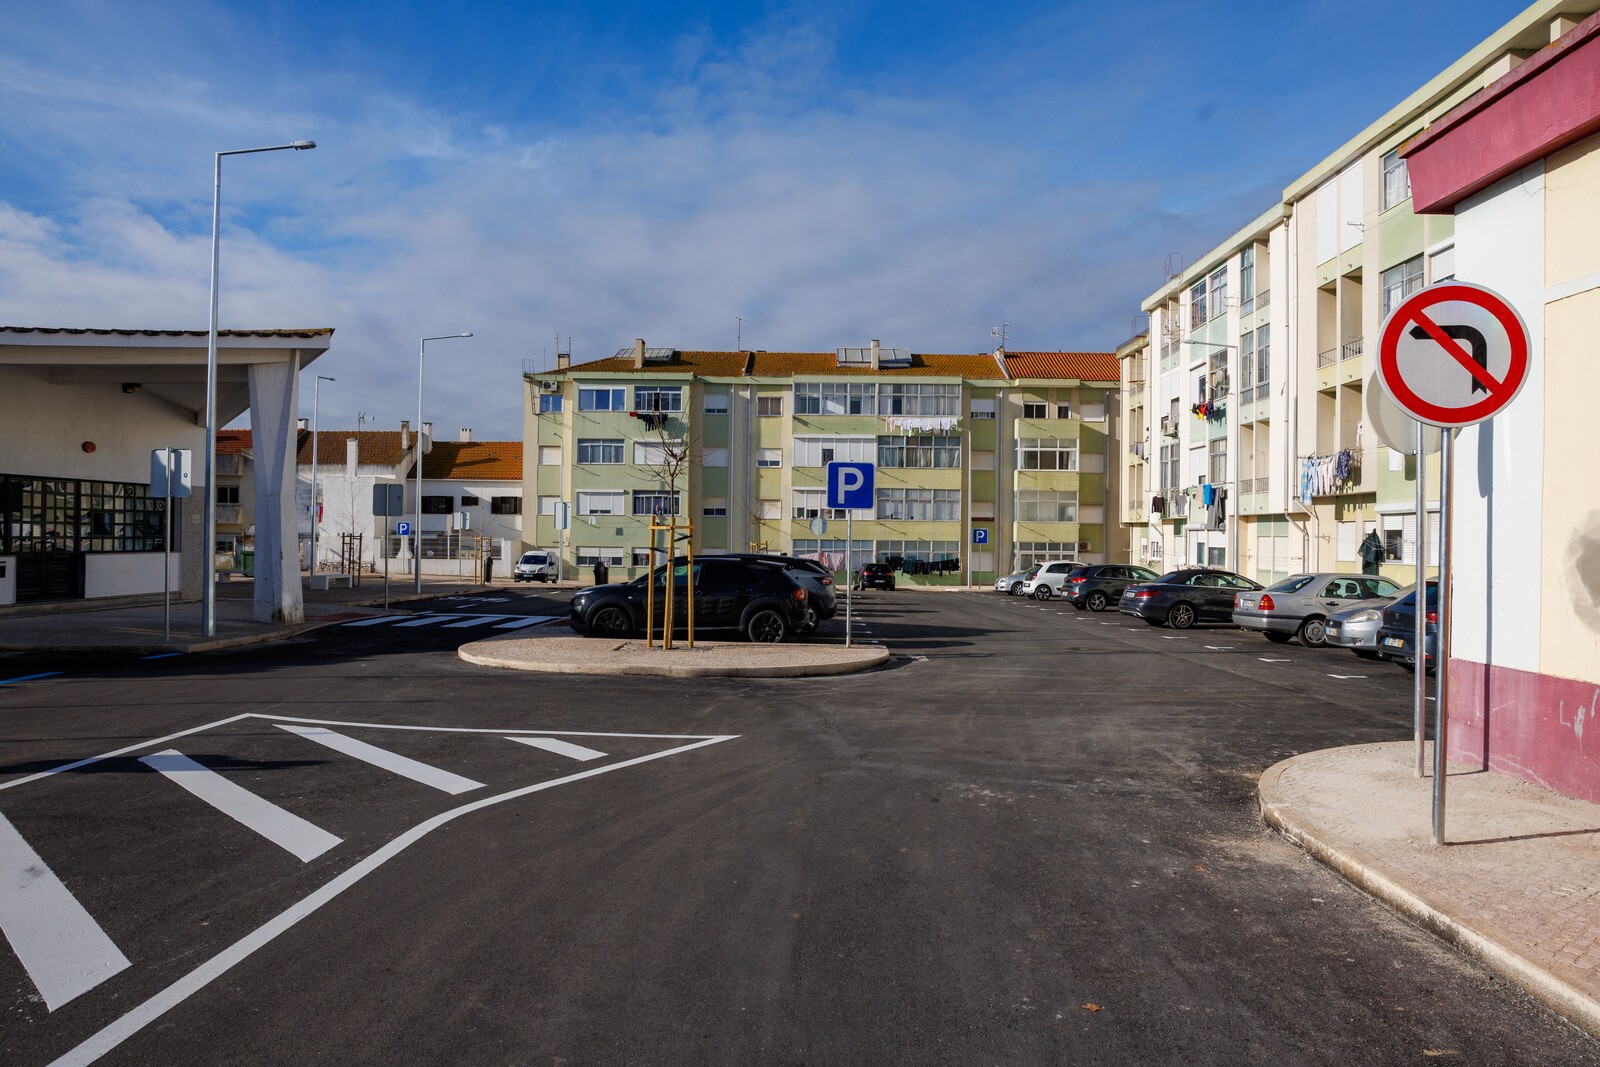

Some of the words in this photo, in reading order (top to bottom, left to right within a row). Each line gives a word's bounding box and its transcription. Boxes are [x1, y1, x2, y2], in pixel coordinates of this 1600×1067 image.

[838, 467, 864, 504] P
[400, 524, 407, 534] P
[976, 531, 985, 542] P
